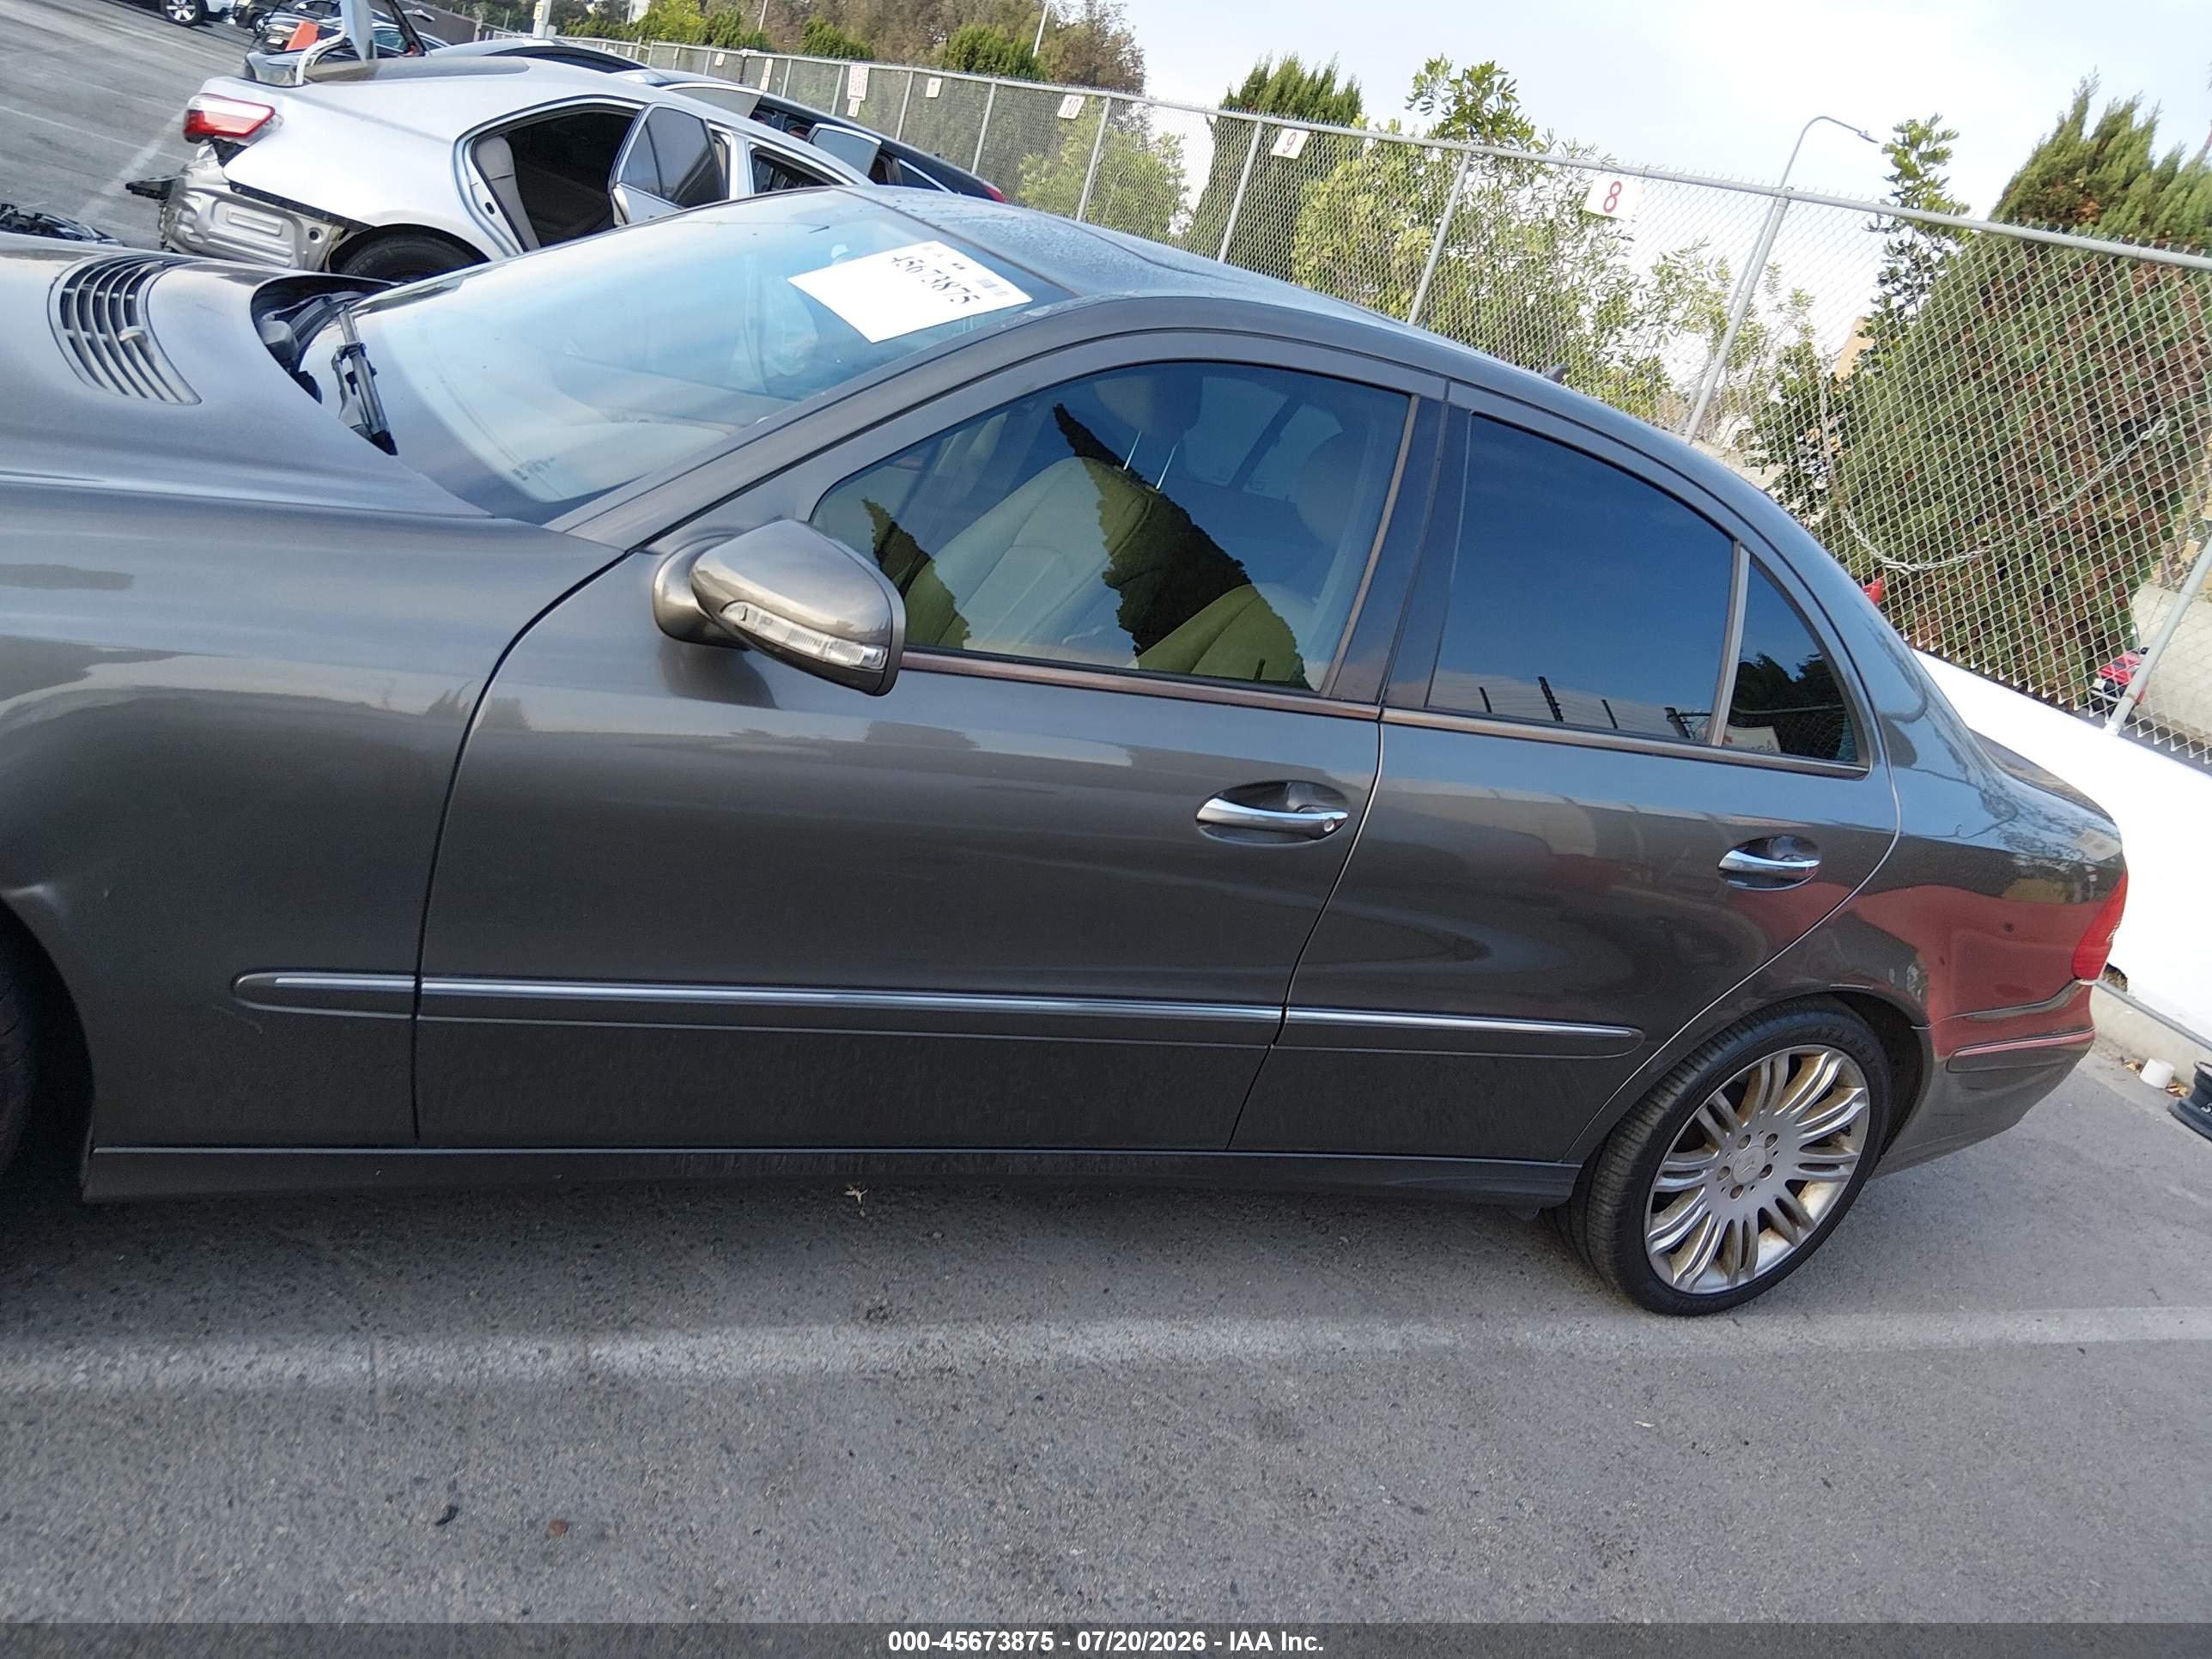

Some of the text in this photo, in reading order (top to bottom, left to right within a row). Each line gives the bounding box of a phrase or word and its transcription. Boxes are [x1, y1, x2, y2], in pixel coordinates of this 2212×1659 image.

[1064, 97, 1079, 116] 10
[1283, 131, 1297, 154] 9
[1603, 181, 1622, 213] 8
[890, 256, 981, 304] 45673875
